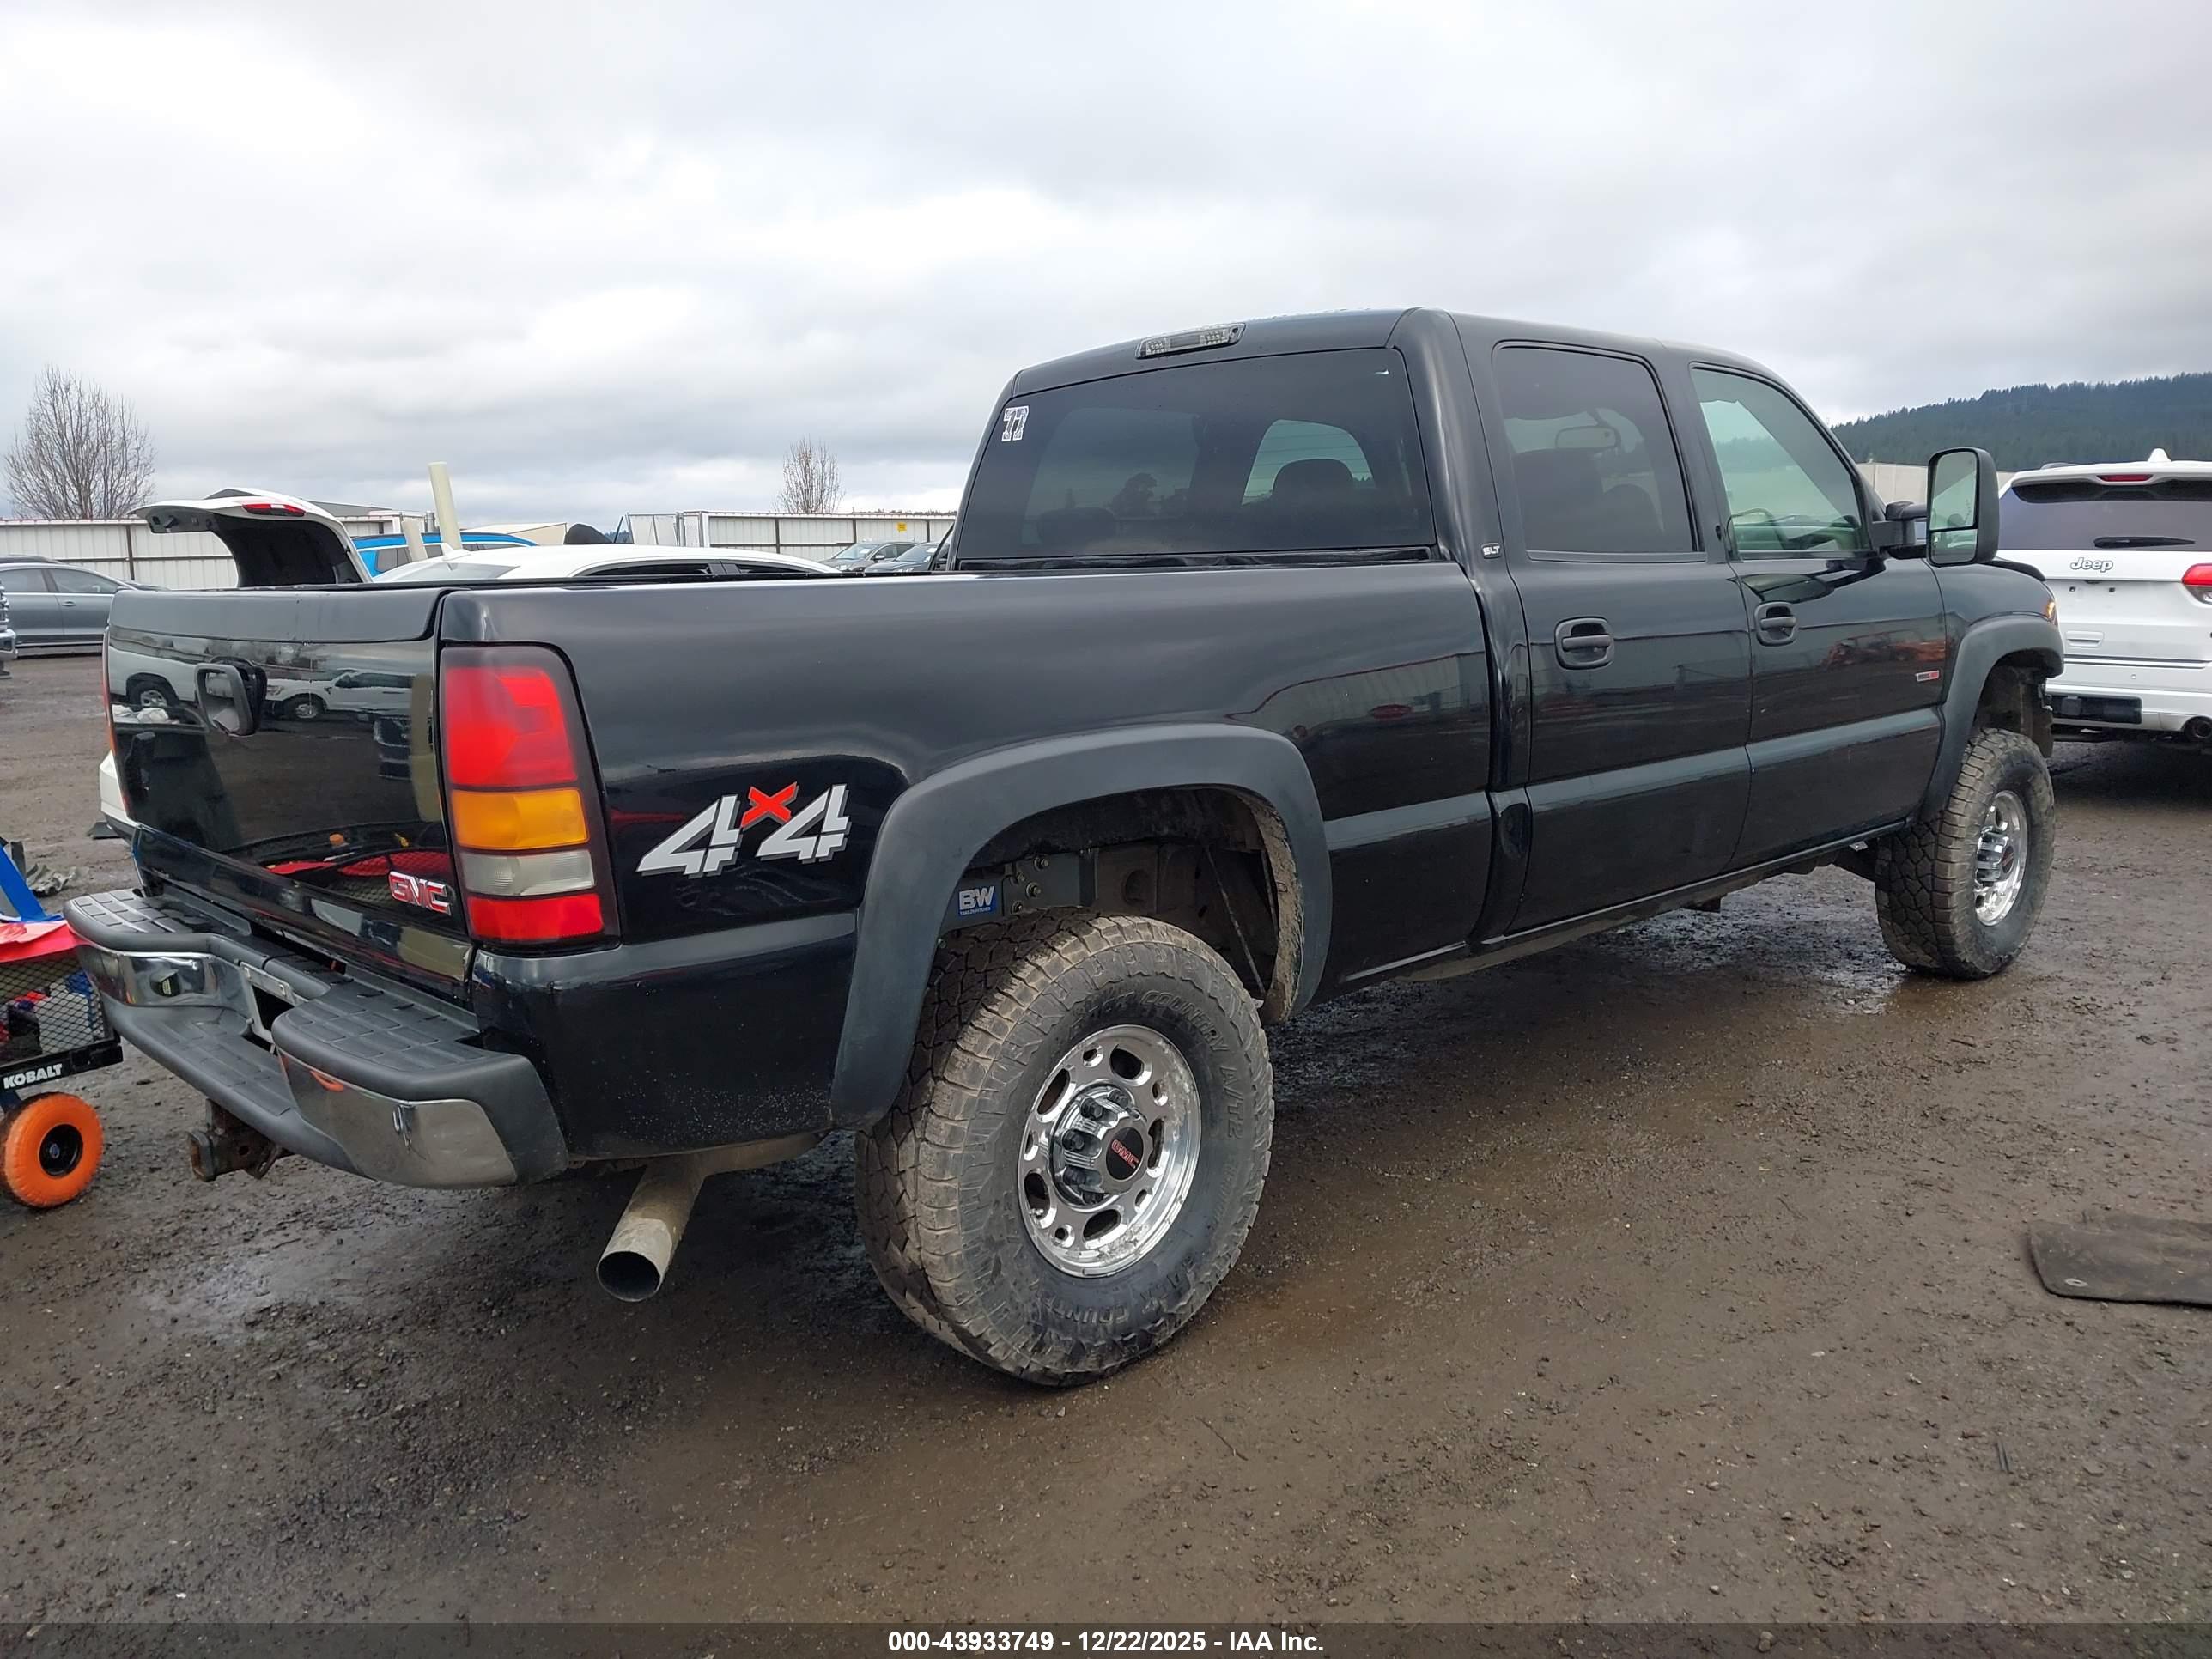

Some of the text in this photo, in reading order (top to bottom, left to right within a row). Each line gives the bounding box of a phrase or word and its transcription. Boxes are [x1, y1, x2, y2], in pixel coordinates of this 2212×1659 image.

[2070, 556, 2113, 573] Jeep
[389, 871, 452, 916] GMC
[1139, 989, 1231, 1052] COUNTRY
[3, 1063, 63, 1089] KOBALT
[1111, 1139, 1139, 1169] GMC
